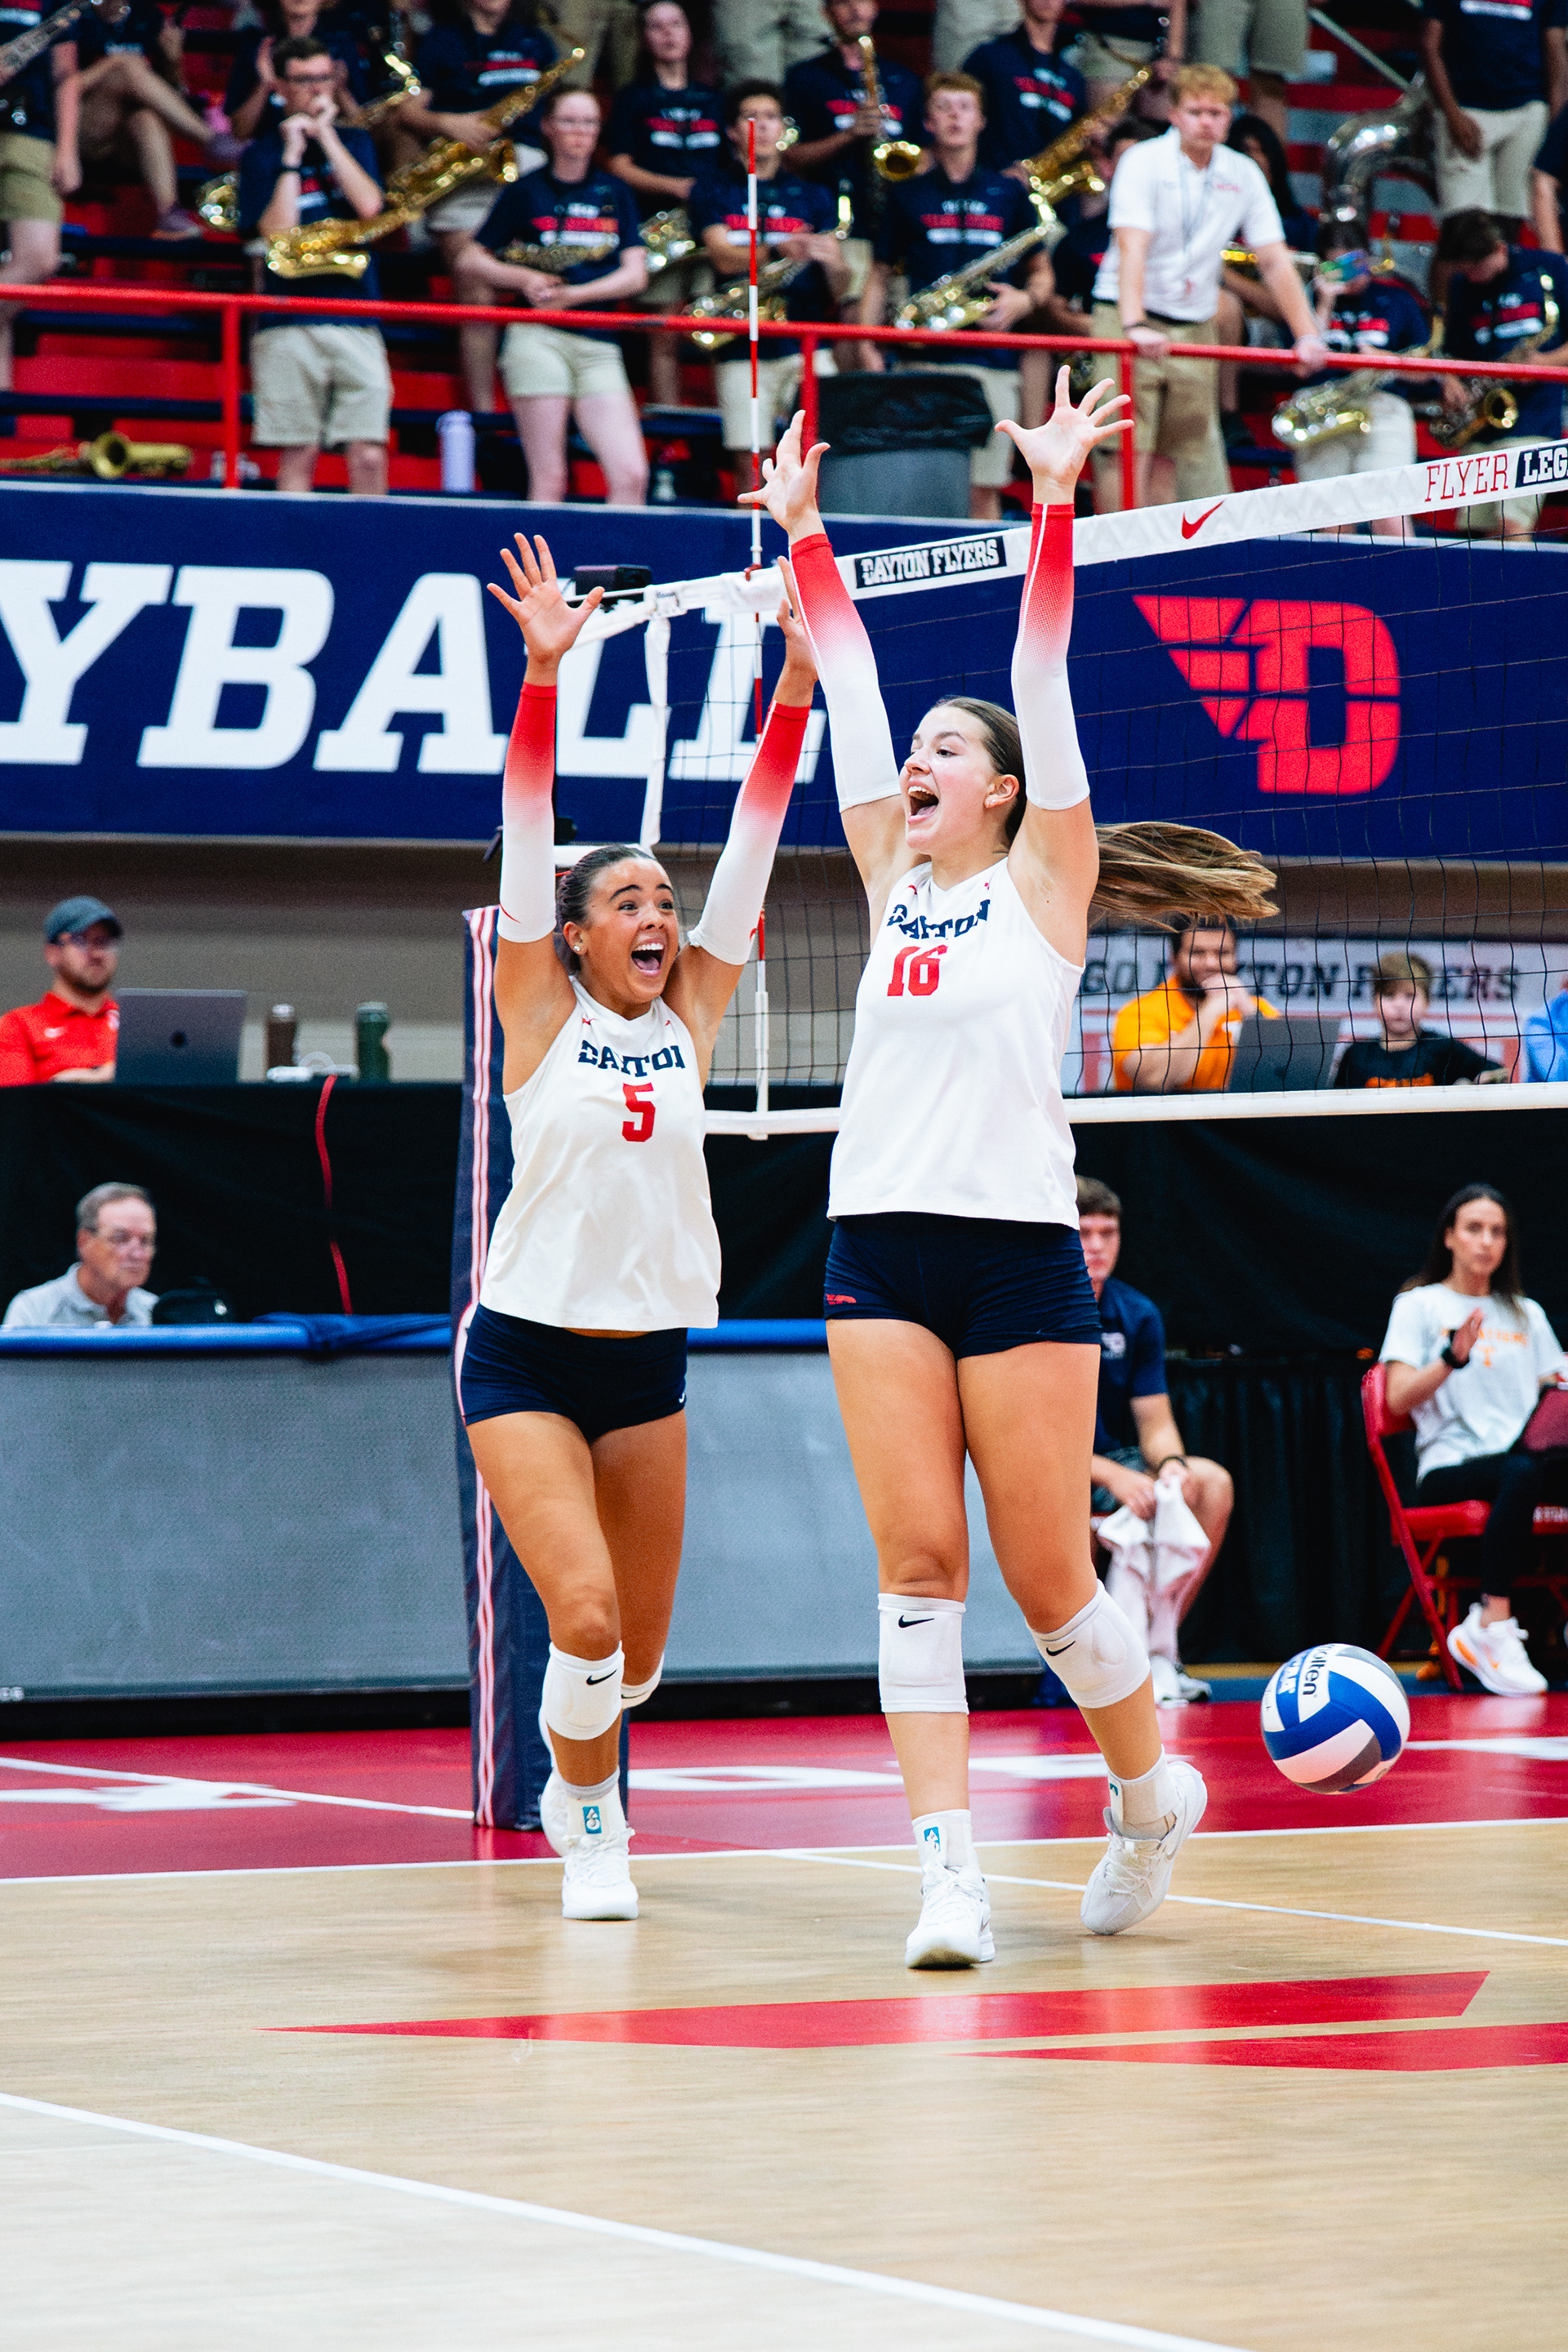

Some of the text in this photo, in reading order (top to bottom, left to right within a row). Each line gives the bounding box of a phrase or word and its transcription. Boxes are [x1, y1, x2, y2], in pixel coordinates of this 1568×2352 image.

[1424, 447, 1568, 502] FLYER LEG
[860, 538, 1000, 586] DAYTON FLYERS
[887, 944, 948, 996] 16
[1082, 959, 1137, 996] GO
[1351, 960, 1520, 1001] FERS
[621, 1082, 656, 1143] 5
